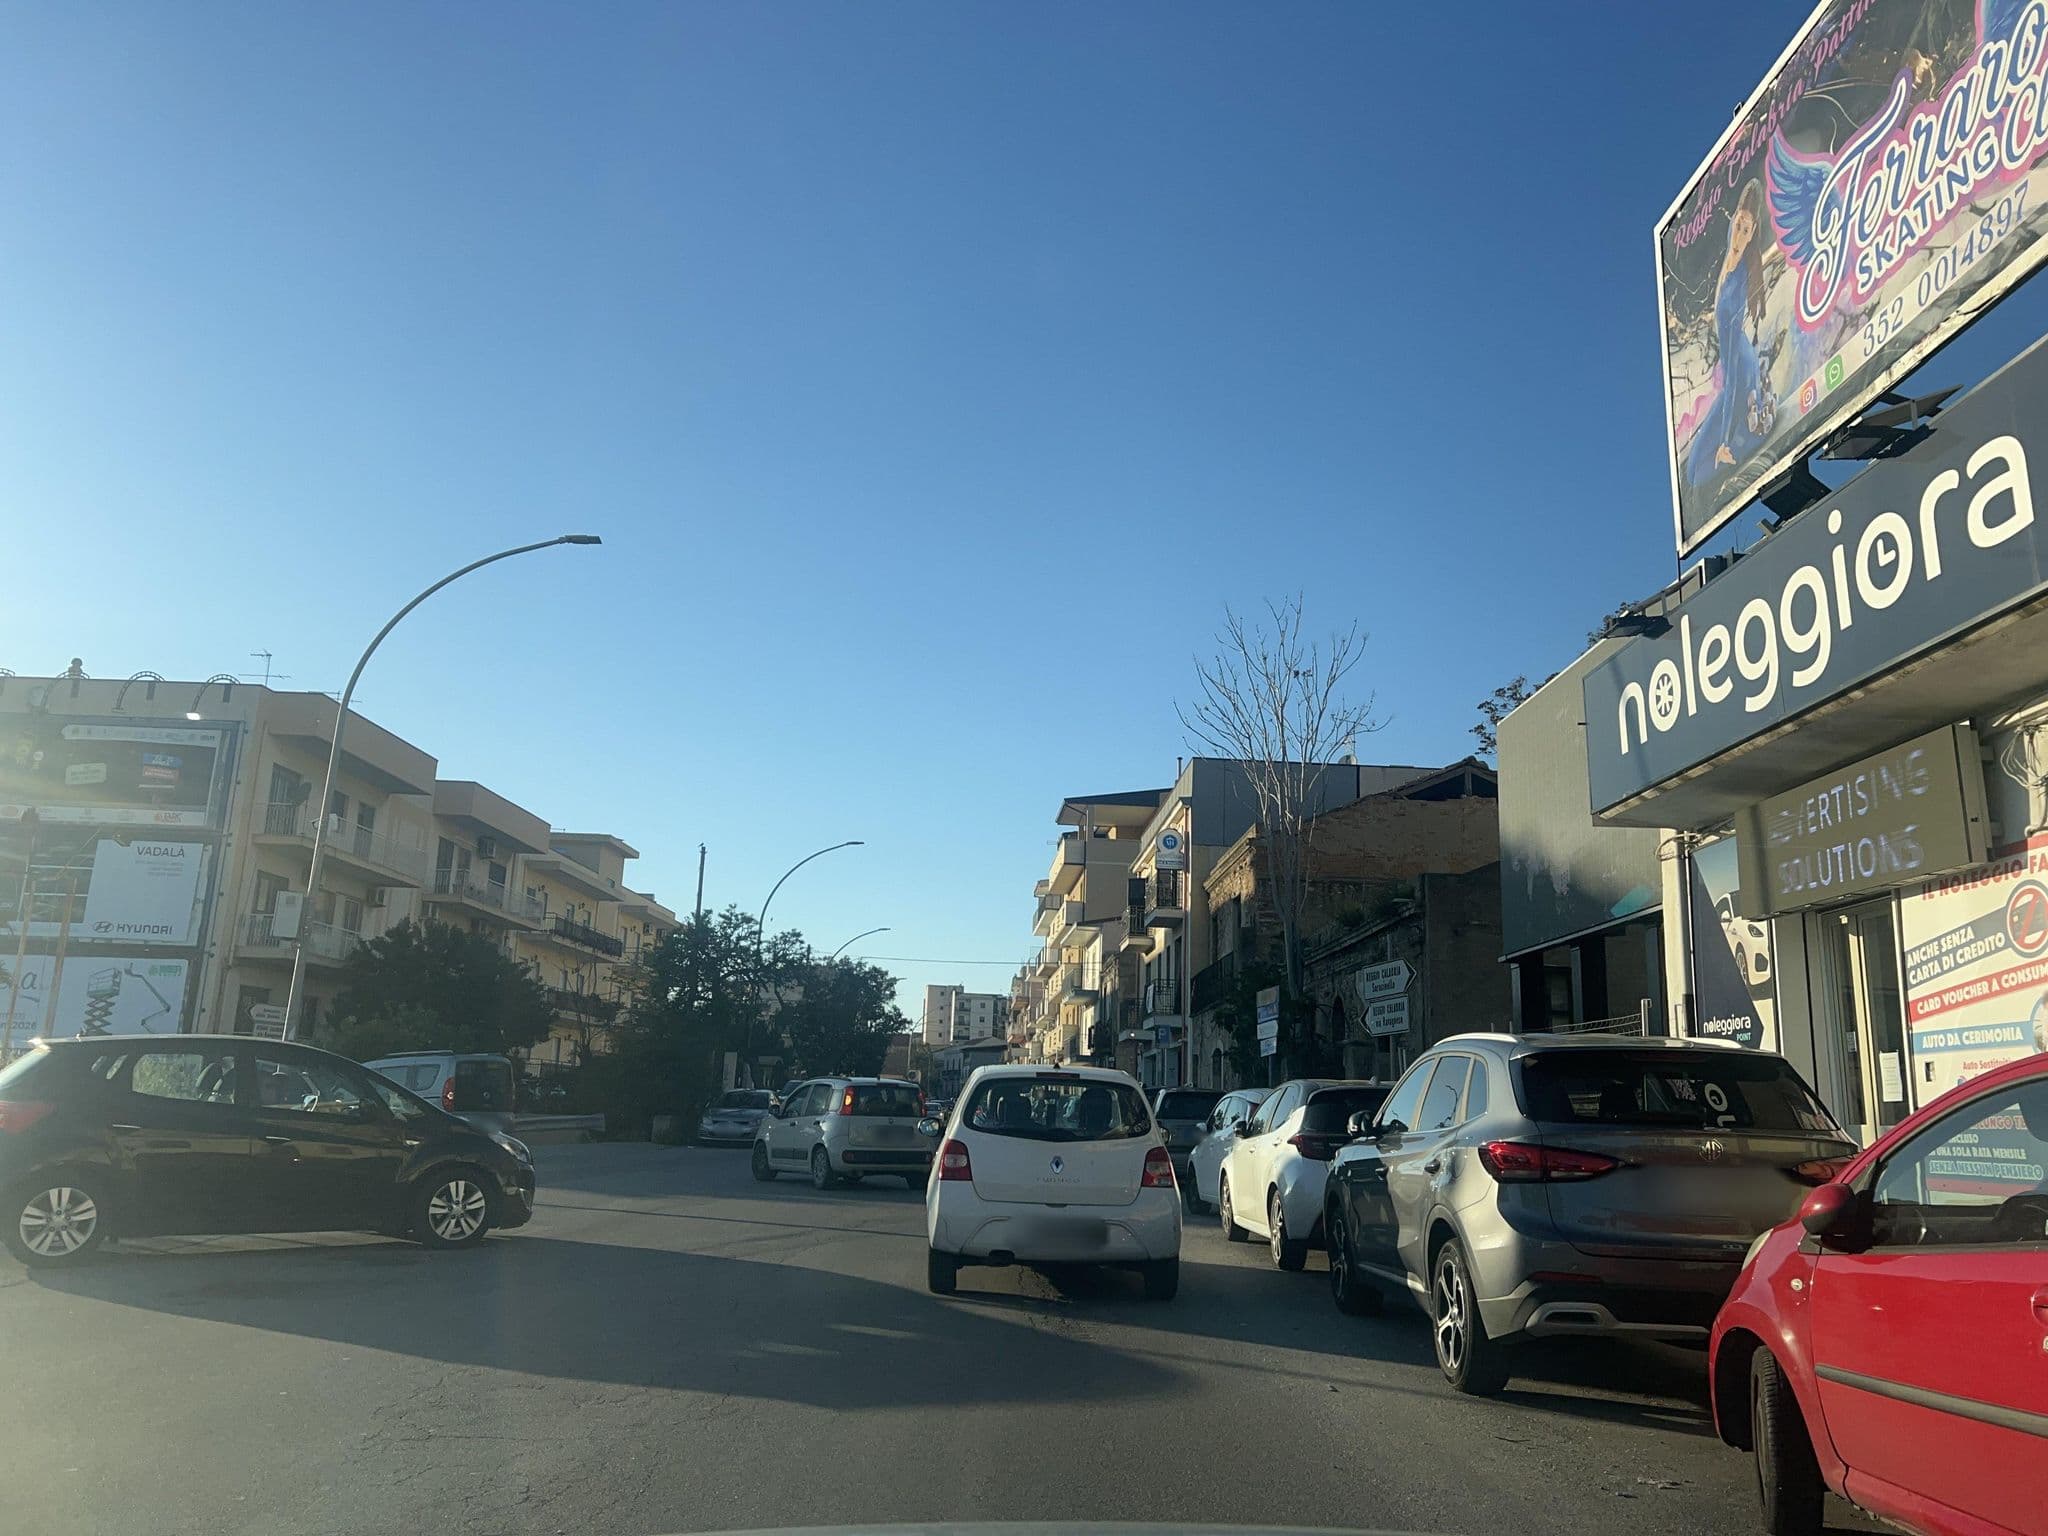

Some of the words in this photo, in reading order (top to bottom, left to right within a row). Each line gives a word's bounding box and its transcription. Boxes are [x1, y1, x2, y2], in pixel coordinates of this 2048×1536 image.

[1674, 184, 1722, 258] Reggio
[1726, 79, 1805, 188] Calabria
[1800, 0, 2048, 322] Ferraro
[1858, 127, 1997, 291] SKATING
[1863, 296, 1904, 357] 352
[1917, 179, 2029, 307] 0014897
[1617, 435, 2035, 755] noleggiora
[1922, 882, 1934, 900] IL
[1939, 859, 2023, 896] NOLEGGIO
[117, 923, 173, 935] HYUNDAI
[1907, 940, 1939, 969] ANCHE
[1940, 926, 1975, 953] SENZA
[1909, 960, 1941, 985] CARTA
[1942, 954, 1955, 970] DI
[1956, 932, 2005, 965] CREDITO
[1917, 996, 1941, 1016] CARD
[1942, 980, 1990, 1008] VOUCHER
[1990, 977, 2000, 992] A
[1703, 1014, 1752, 1035] noleggiora
[1736, 1033, 1752, 1042] POINT
[1922, 1033, 1946, 1049] AUTO
[1946, 1031, 1960, 1046] DA
[1962, 1026, 2024, 1045] CERIMONIA
[1962, 1060, 1979, 1071] Auto
[1953, 1146, 1972, 1158] SOLA
[1992, 1148, 2027, 1160] MENSILE
[1994, 1163, 2044, 1181] PENSIERO
